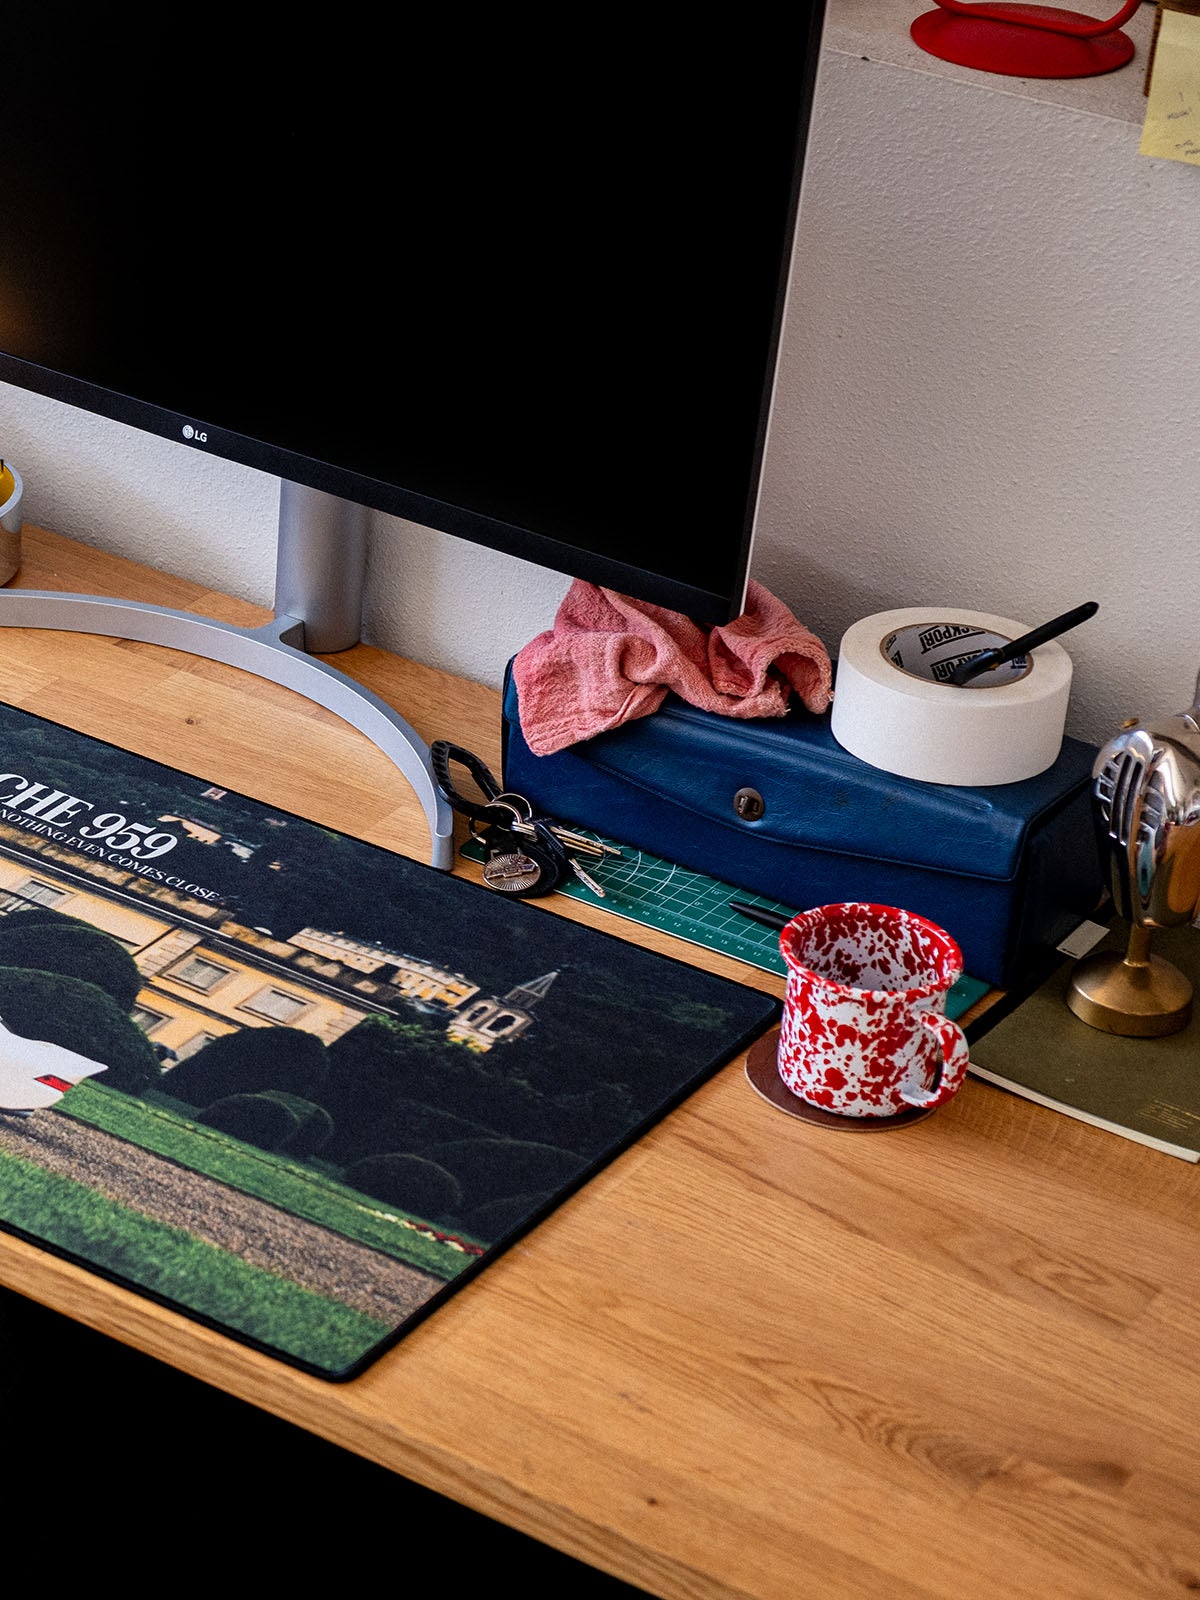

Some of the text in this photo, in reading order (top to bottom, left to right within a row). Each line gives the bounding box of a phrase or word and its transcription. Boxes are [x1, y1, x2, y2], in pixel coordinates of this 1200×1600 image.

[79, 812, 178, 859] 959
[65, 836, 110, 858] EVEN
[107, 853, 164, 881] COMES
[165, 875, 220, 902] CLOSE
